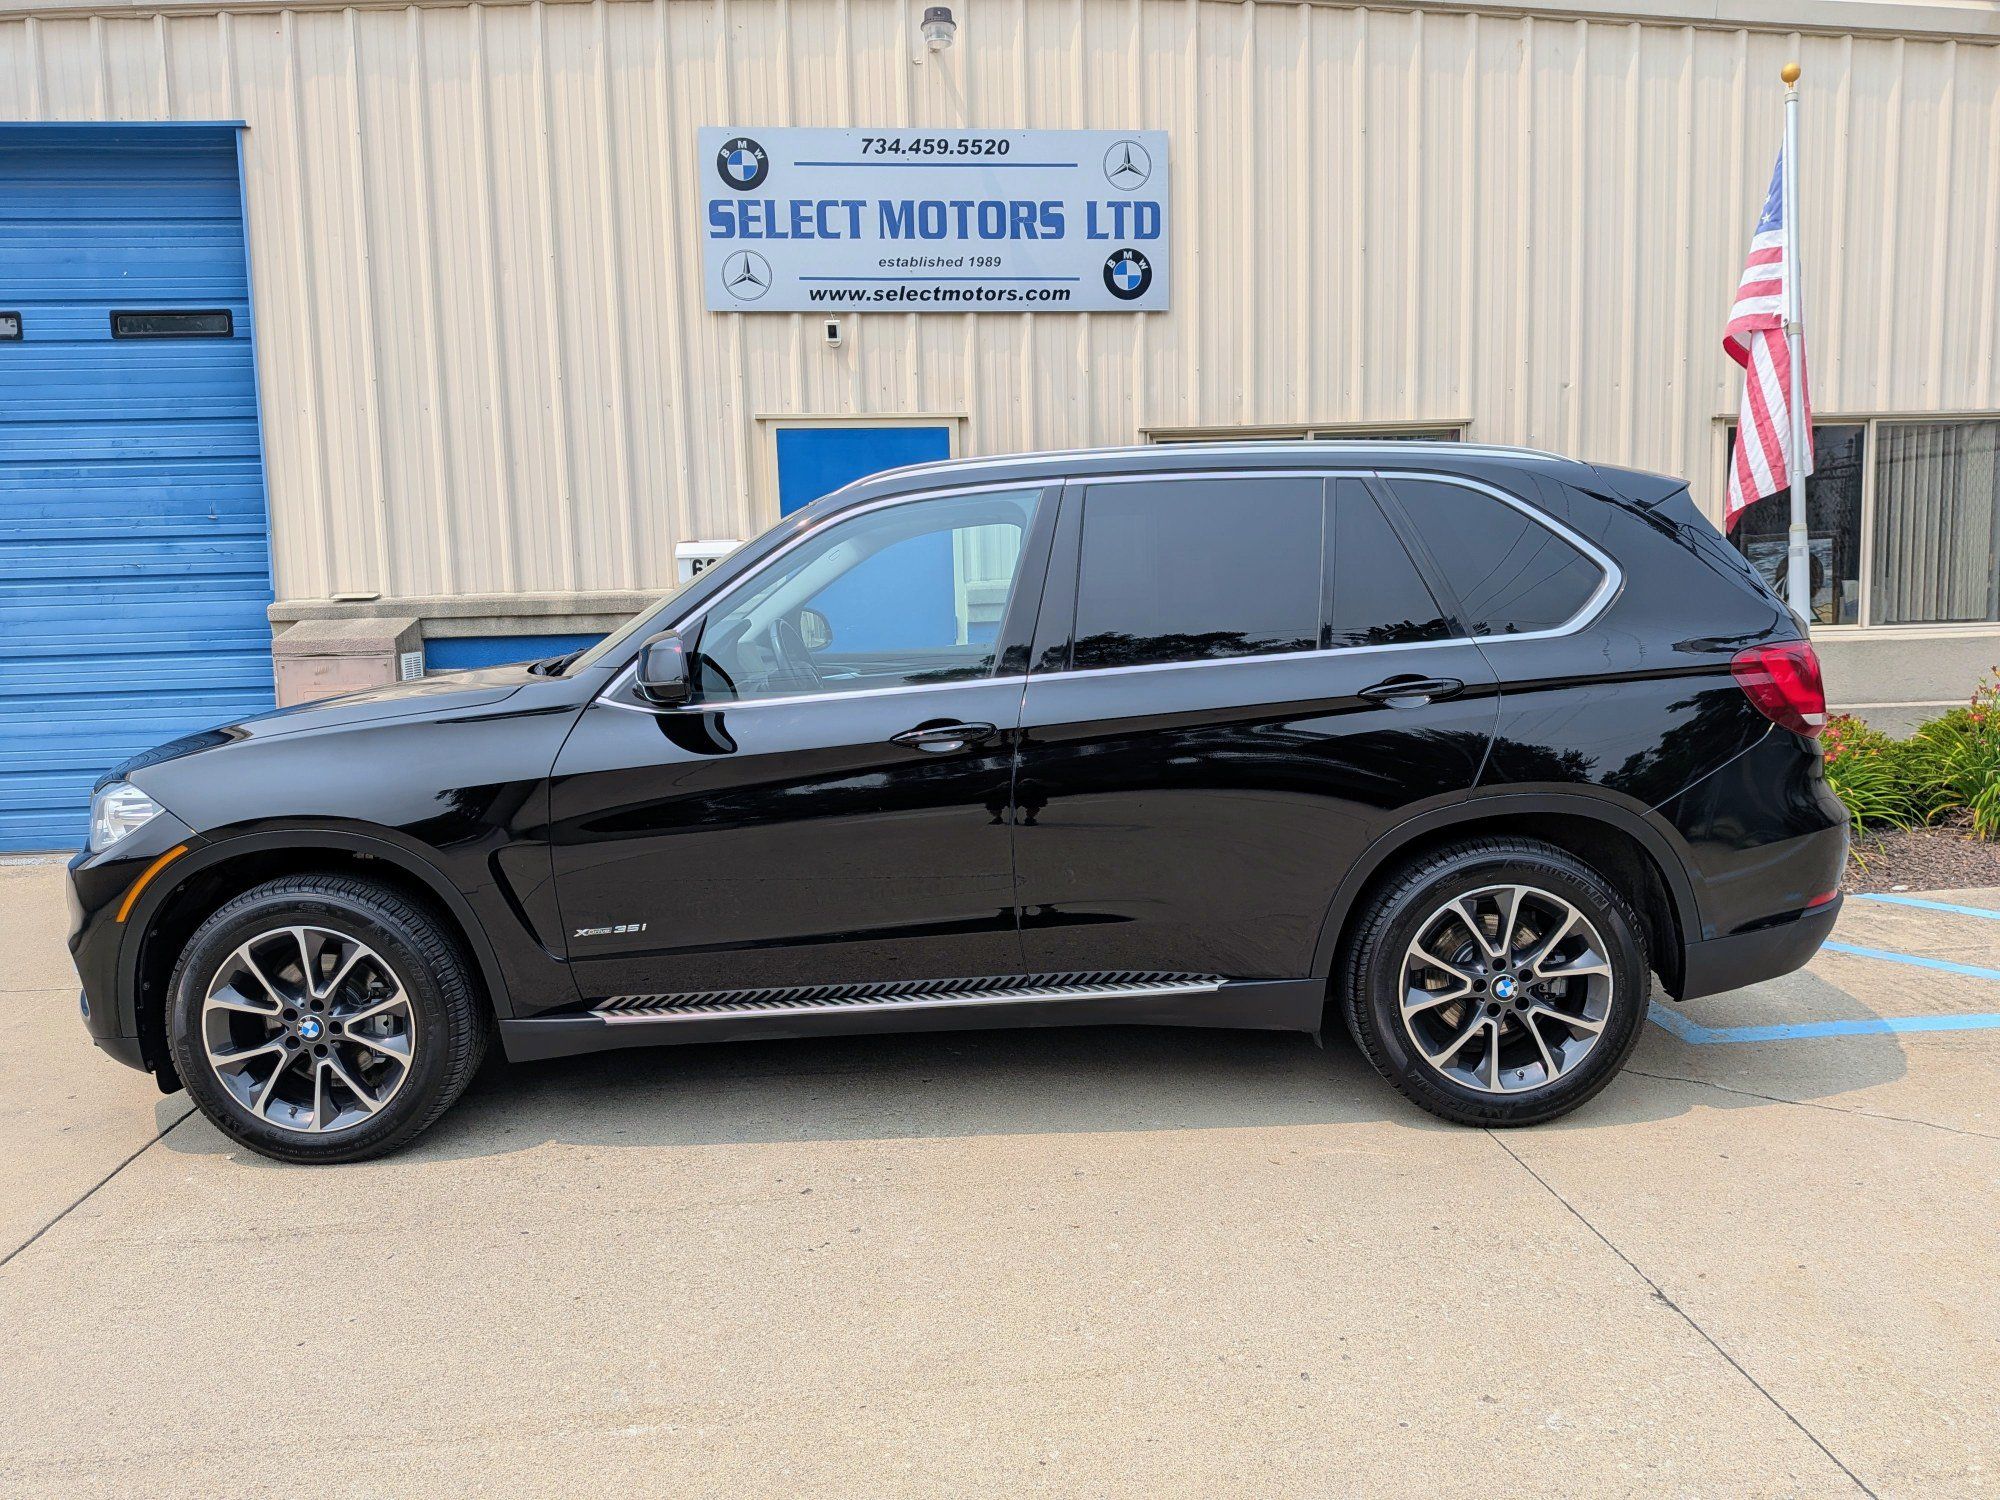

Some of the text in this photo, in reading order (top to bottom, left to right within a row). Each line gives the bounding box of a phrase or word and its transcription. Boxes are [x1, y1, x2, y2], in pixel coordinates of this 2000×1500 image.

[720, 140, 765, 160] BMW
[861, 138, 1010, 155] 734.459.5520
[708, 199, 1161, 240] SELECT MOTORS LTD
[878, 256, 1001, 267] established 1989
[1106, 250, 1149, 270] BMW
[809, 285, 1071, 302] www.selectmotors.com
